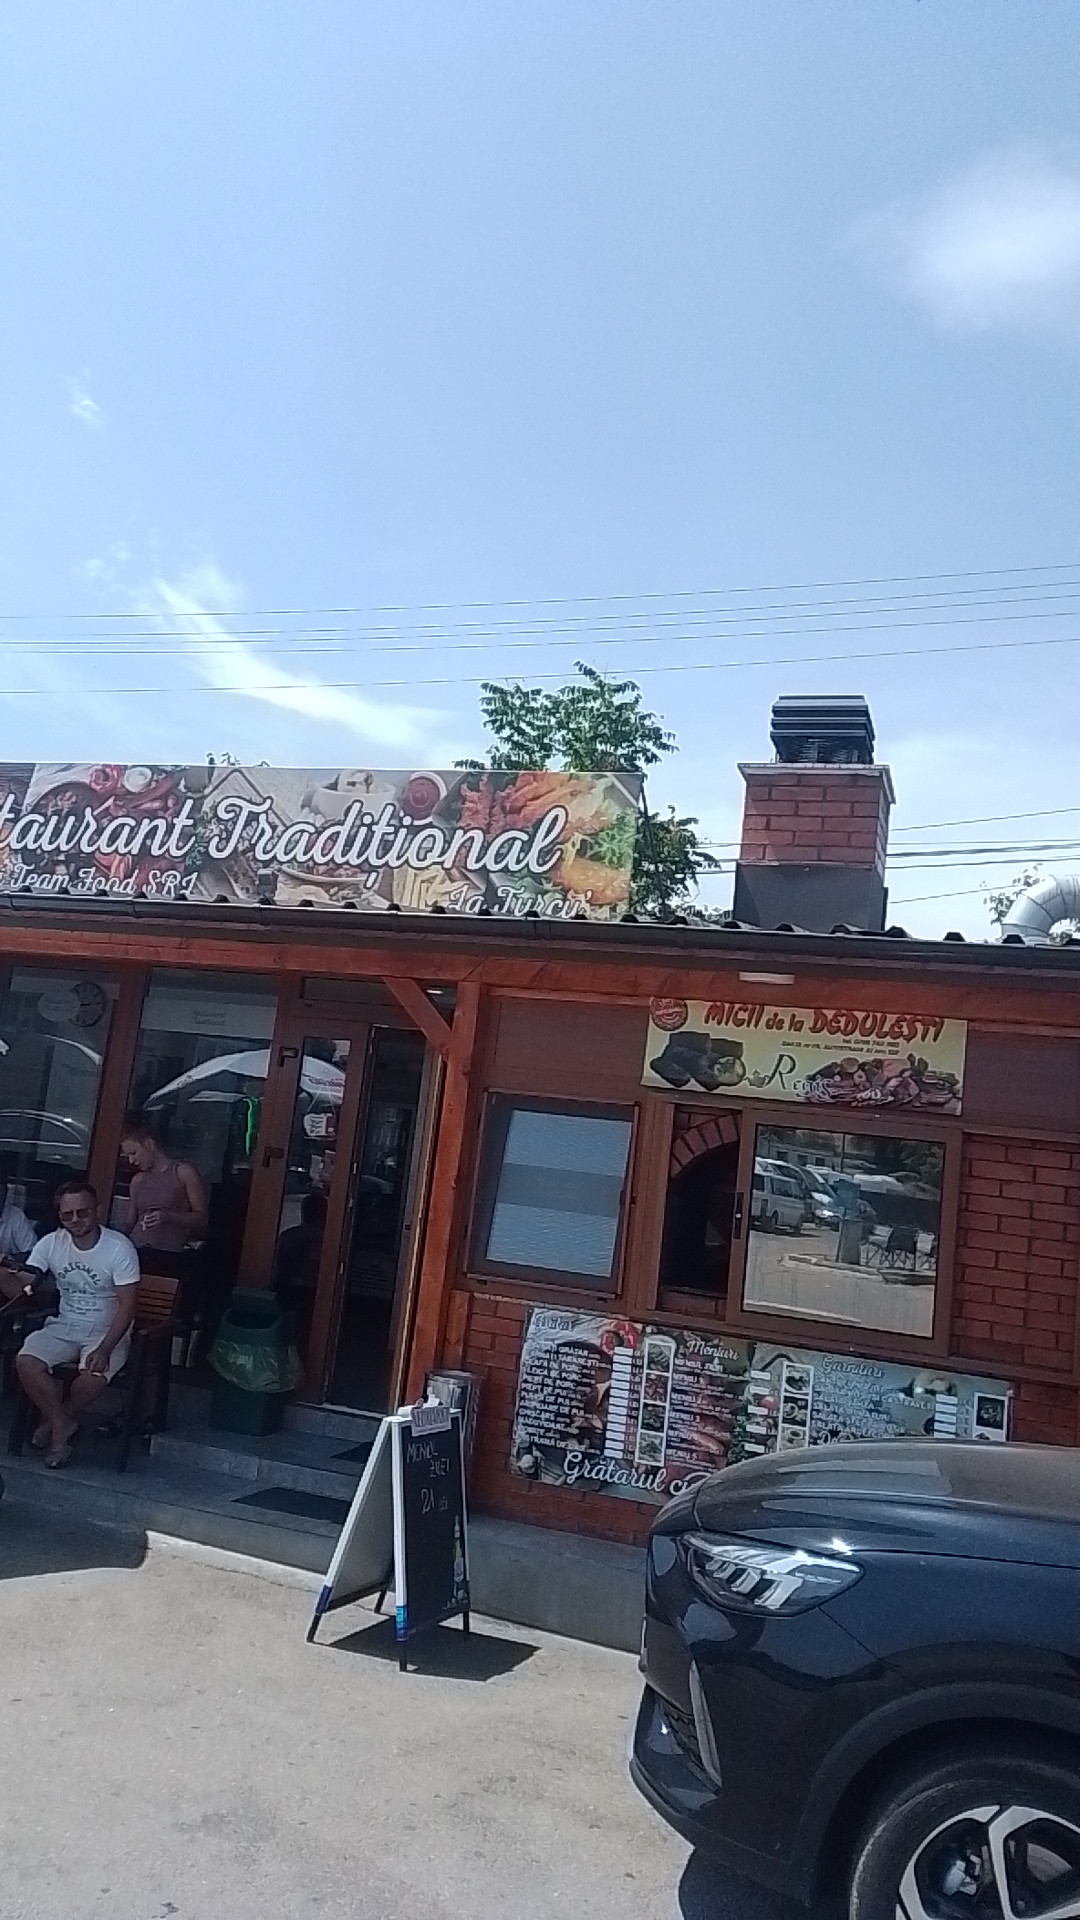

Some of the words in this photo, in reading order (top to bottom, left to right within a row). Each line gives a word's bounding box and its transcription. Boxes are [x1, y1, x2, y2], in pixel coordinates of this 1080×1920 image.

[11, 863, 69, 889] Team
[76, 867, 138, 894] Food
[703, 1001, 764, 1030] MICII
[765, 1012, 785, 1031] de
[788, 1013, 805, 1032] la
[58, 1261, 101, 1286] ORIGINAL
[687, 1340, 740, 1361] Meniuri
[563, 1450, 666, 1494] Grătarul
